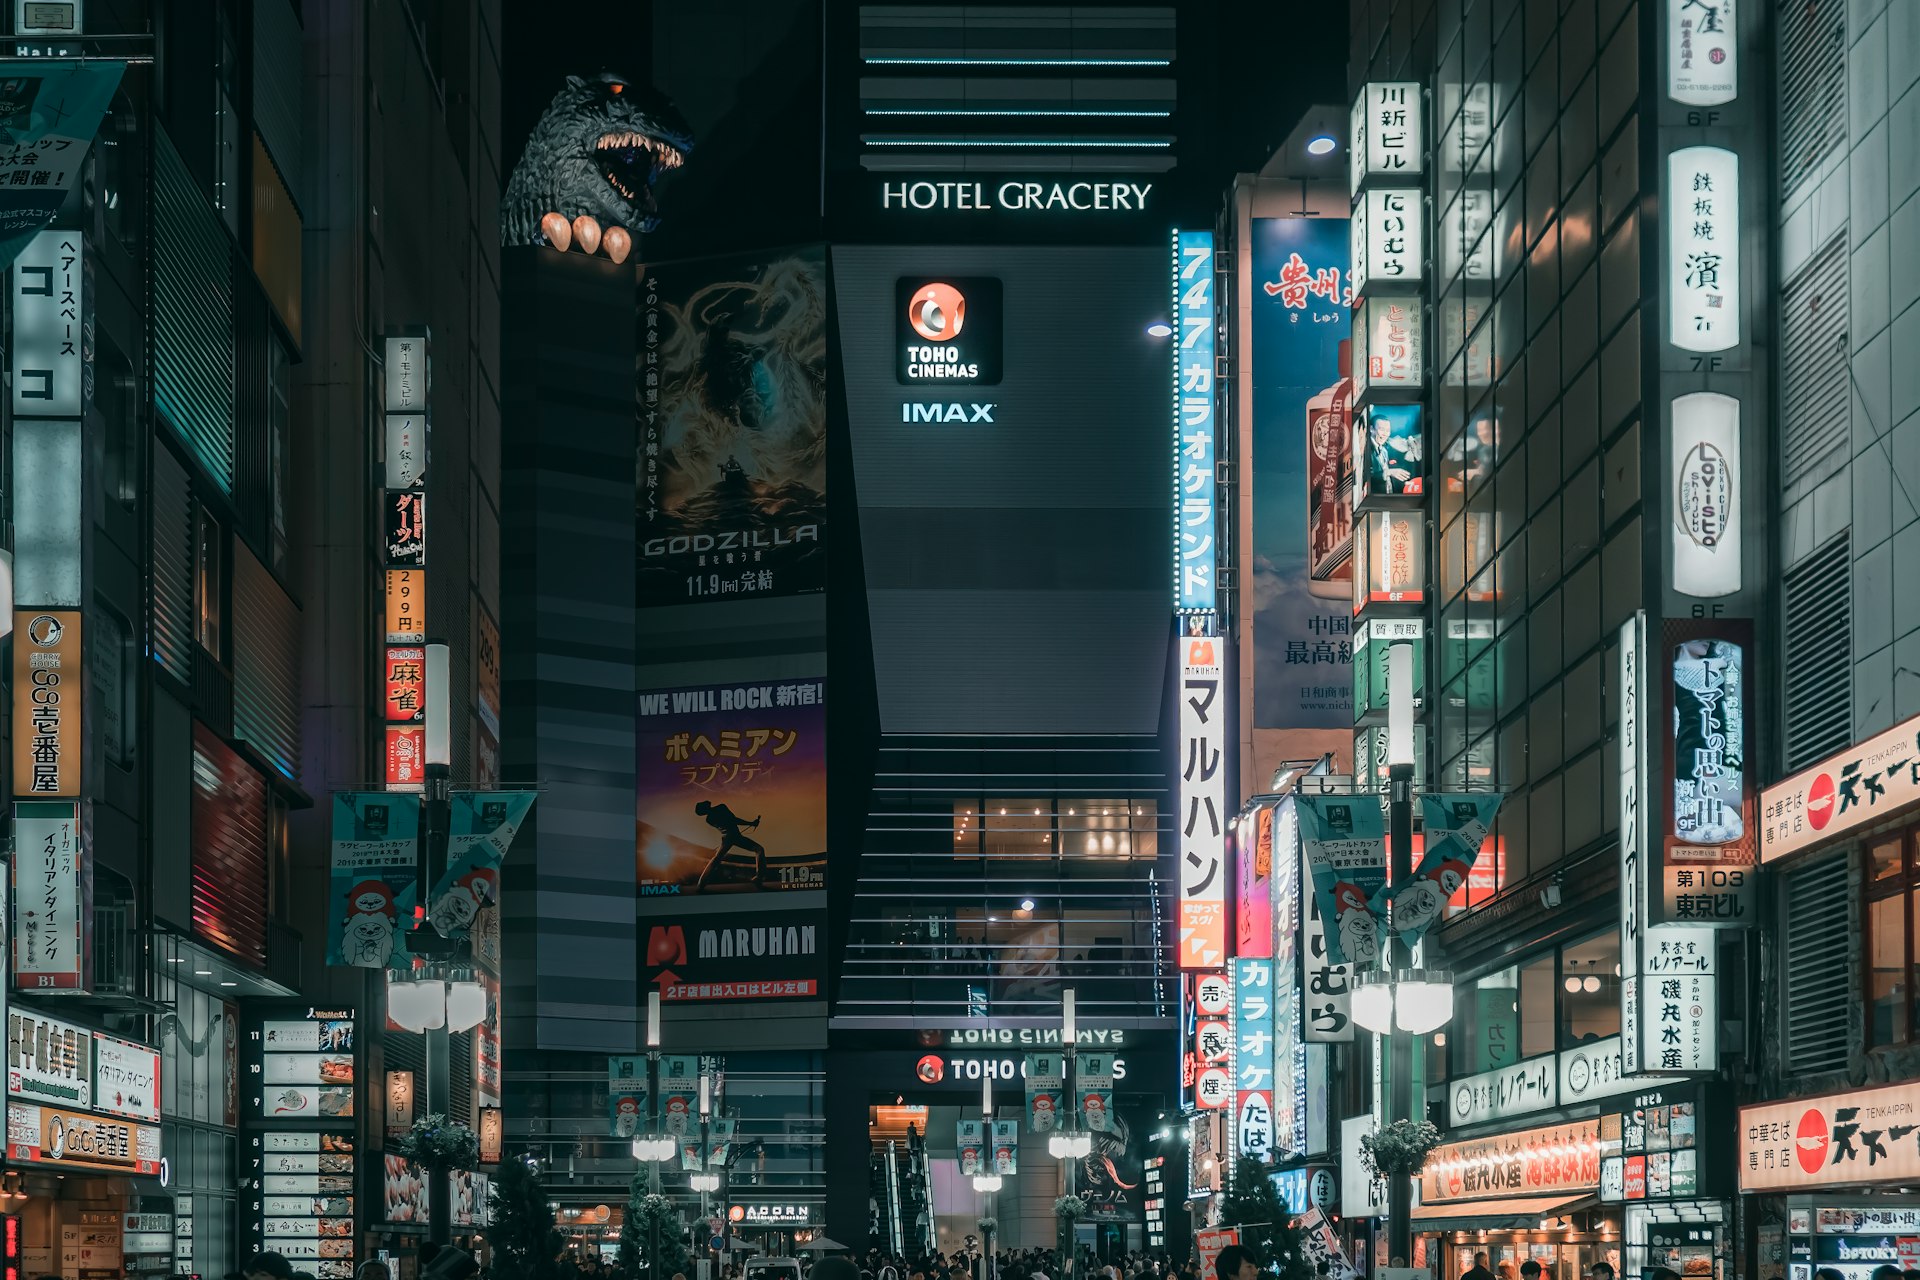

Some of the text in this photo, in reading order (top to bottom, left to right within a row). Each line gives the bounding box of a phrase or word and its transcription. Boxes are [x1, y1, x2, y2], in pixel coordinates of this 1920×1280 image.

[17, 46, 67, 57] Hair
[1381, 87, 1407, 169] 川新ビル
[884, 182, 1152, 210] HOTEL GRACERY
[1693, 172, 1714, 241] 鉄板焼
[1384, 193, 1404, 276] にいむら
[1264, 253, 1352, 309] 貴州
[1685, 252, 1723, 291] 濱
[60, 241, 76, 357] ヘアースペース
[907, 346, 959, 362] TOHO
[1387, 304, 1408, 381] ととりこ
[907, 364, 979, 378] CINEMAS
[902, 403, 995, 422] IMAX
[1180, 247, 1212, 597] 747 カラオケランド
[396, 494, 414, 543] ダーツ
[645, 525, 818, 557] GODZILLA
[687, 573, 719, 597] 11.9
[399, 570, 413, 630] 299円
[1308, 615, 1349, 635] 中国
[389, 663, 421, 711] 麻雀
[640, 694, 669, 717] WE
[672, 690, 717, 714] WILL
[721, 686, 773, 711] ROCK
[665, 728, 797, 762] ボヘミアン
[1692, 658, 1726, 829] トマトの思い出
[1868, 741, 1908, 766] TENKAIPPIN
[679, 761, 776, 791] ラプソディ
[1183, 679, 1220, 897] マルハン
[1766, 791, 1803, 822] 中華そば
[1766, 815, 1803, 844] 専門店
[339, 840, 411, 854] ラグビーワールドカップ
[778, 866, 809, 884] 11.9
[44, 833, 58, 960] イタリアンダイニング
[641, 885, 681, 896] IMAX
[1676, 893, 1744, 918] 東京ビル
[698, 925, 816, 959] MARUHAN
[1649, 955, 1710, 971] ルノアール
[38, 975, 57, 988] B1
[666, 979, 809, 999] 2F店舗出入口はビル左側
[1202, 985, 1219, 1001] 売
[250, 1031, 260, 1040] 11
[1239, 960, 1274, 1089] カラオケ
[1660, 979, 1683, 1069] 磯丸水産
[98, 1065, 154, 1089] イタリアンダイニング
[250, 1064, 260, 1074] 10
[950, 1058, 1016, 1080] TOHO
[1202, 1079, 1219, 1096] 煙
[253, 1096, 261, 1106] 9
[1865, 1103, 1914, 1119] TENKAIPPIN
[67, 1120, 129, 1157] CoCo壱番屋
[251, 1137, 260, 1147] 8
[1749, 1120, 1791, 1144] 中華そば
[1831, 1107, 1920, 1166] 天下一
[252, 1158, 260, 1168] 7
[1749, 1147, 1791, 1170] 専門店
[251, 1180, 260, 1190] 6
[251, 1201, 260, 1211] 5
[64, 1232, 78, 1241] 5F
[251, 1222, 260, 1232] 4
[64, 1254, 78, 1262] 4F
[251, 1243, 260, 1253] 3
